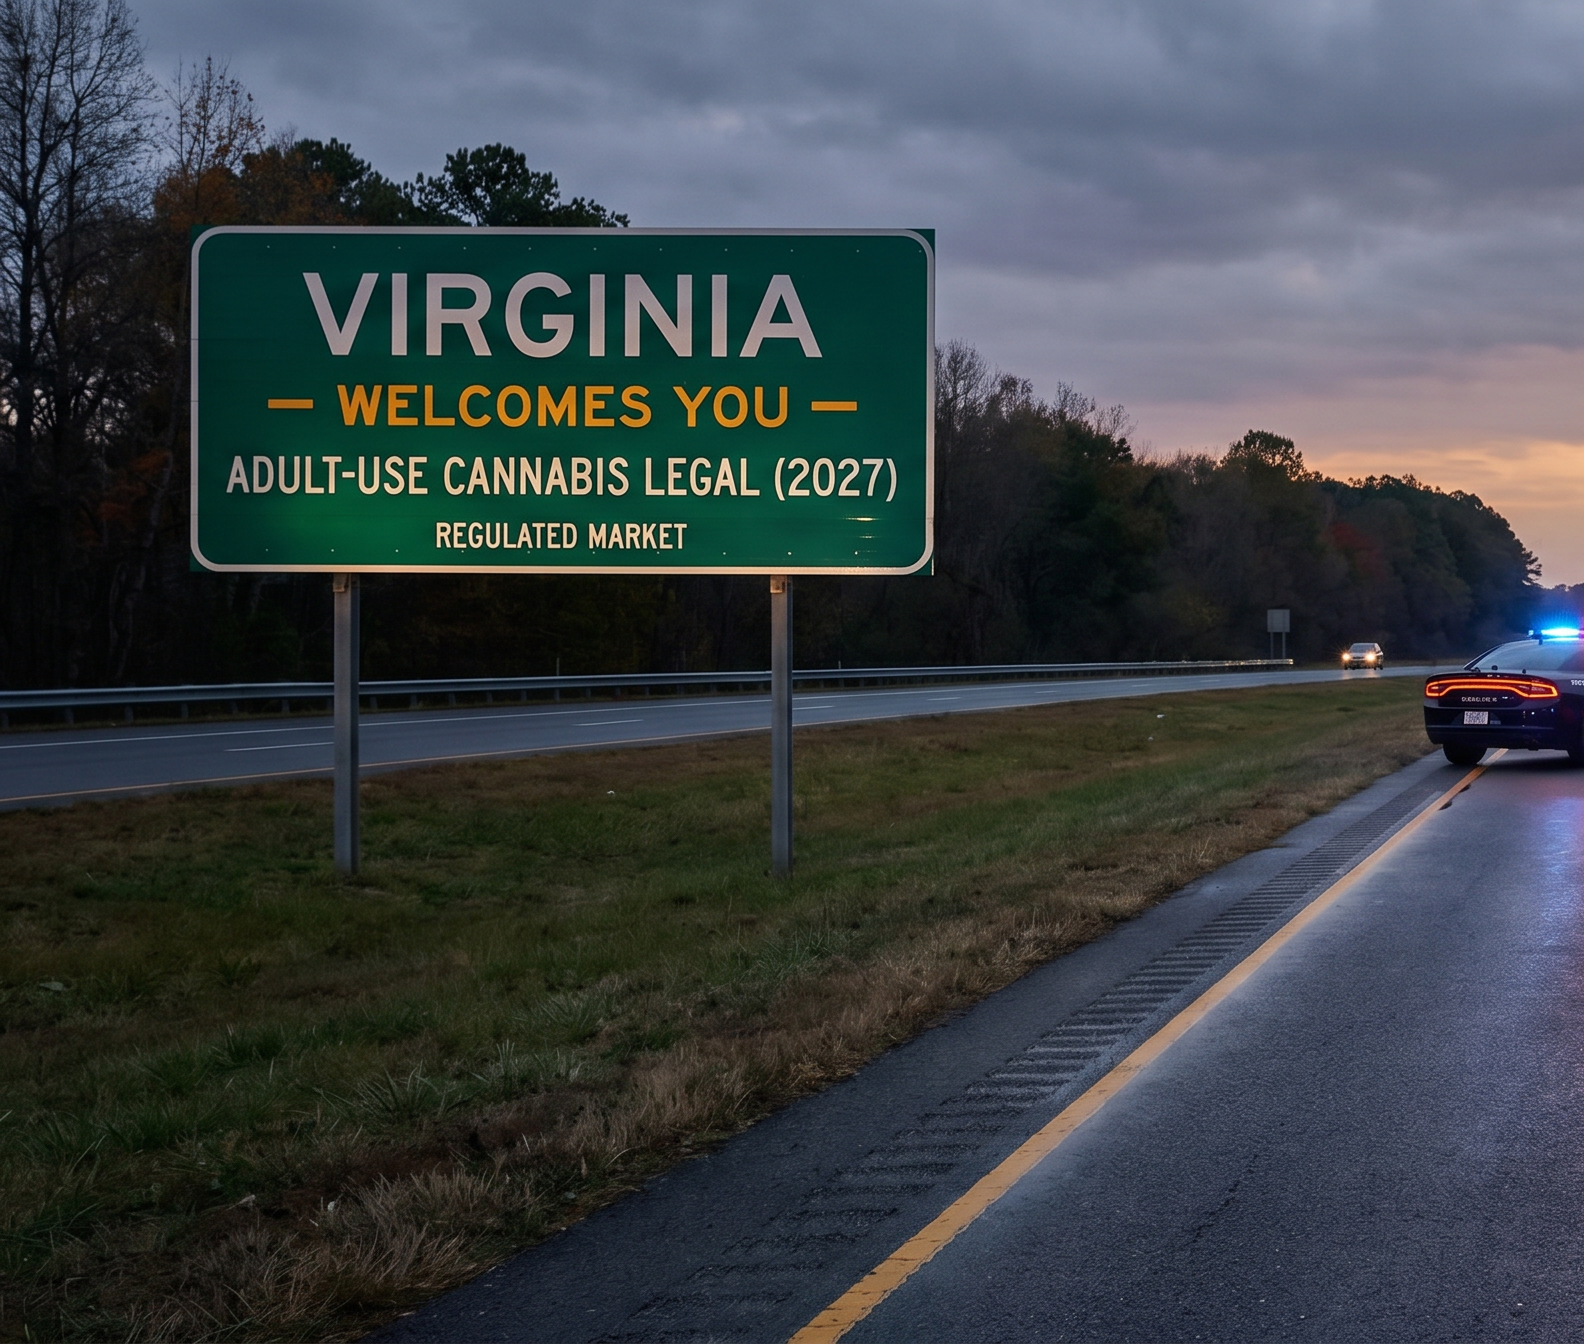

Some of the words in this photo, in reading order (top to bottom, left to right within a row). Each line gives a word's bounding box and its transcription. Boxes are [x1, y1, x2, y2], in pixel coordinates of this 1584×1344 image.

[302, 271, 823, 359] VIRGINIA
[337, 384, 652, 428] WELCOMES
[672, 385, 788, 428] YOU
[226, 455, 429, 495] ADULT-USE
[443, 456, 630, 497] CANNABIS
[645, 457, 761, 497] LEGAL
[774, 457, 897, 502] (2027)
[436, 521, 578, 549] REGULATED
[588, 523, 688, 550] MARKET
